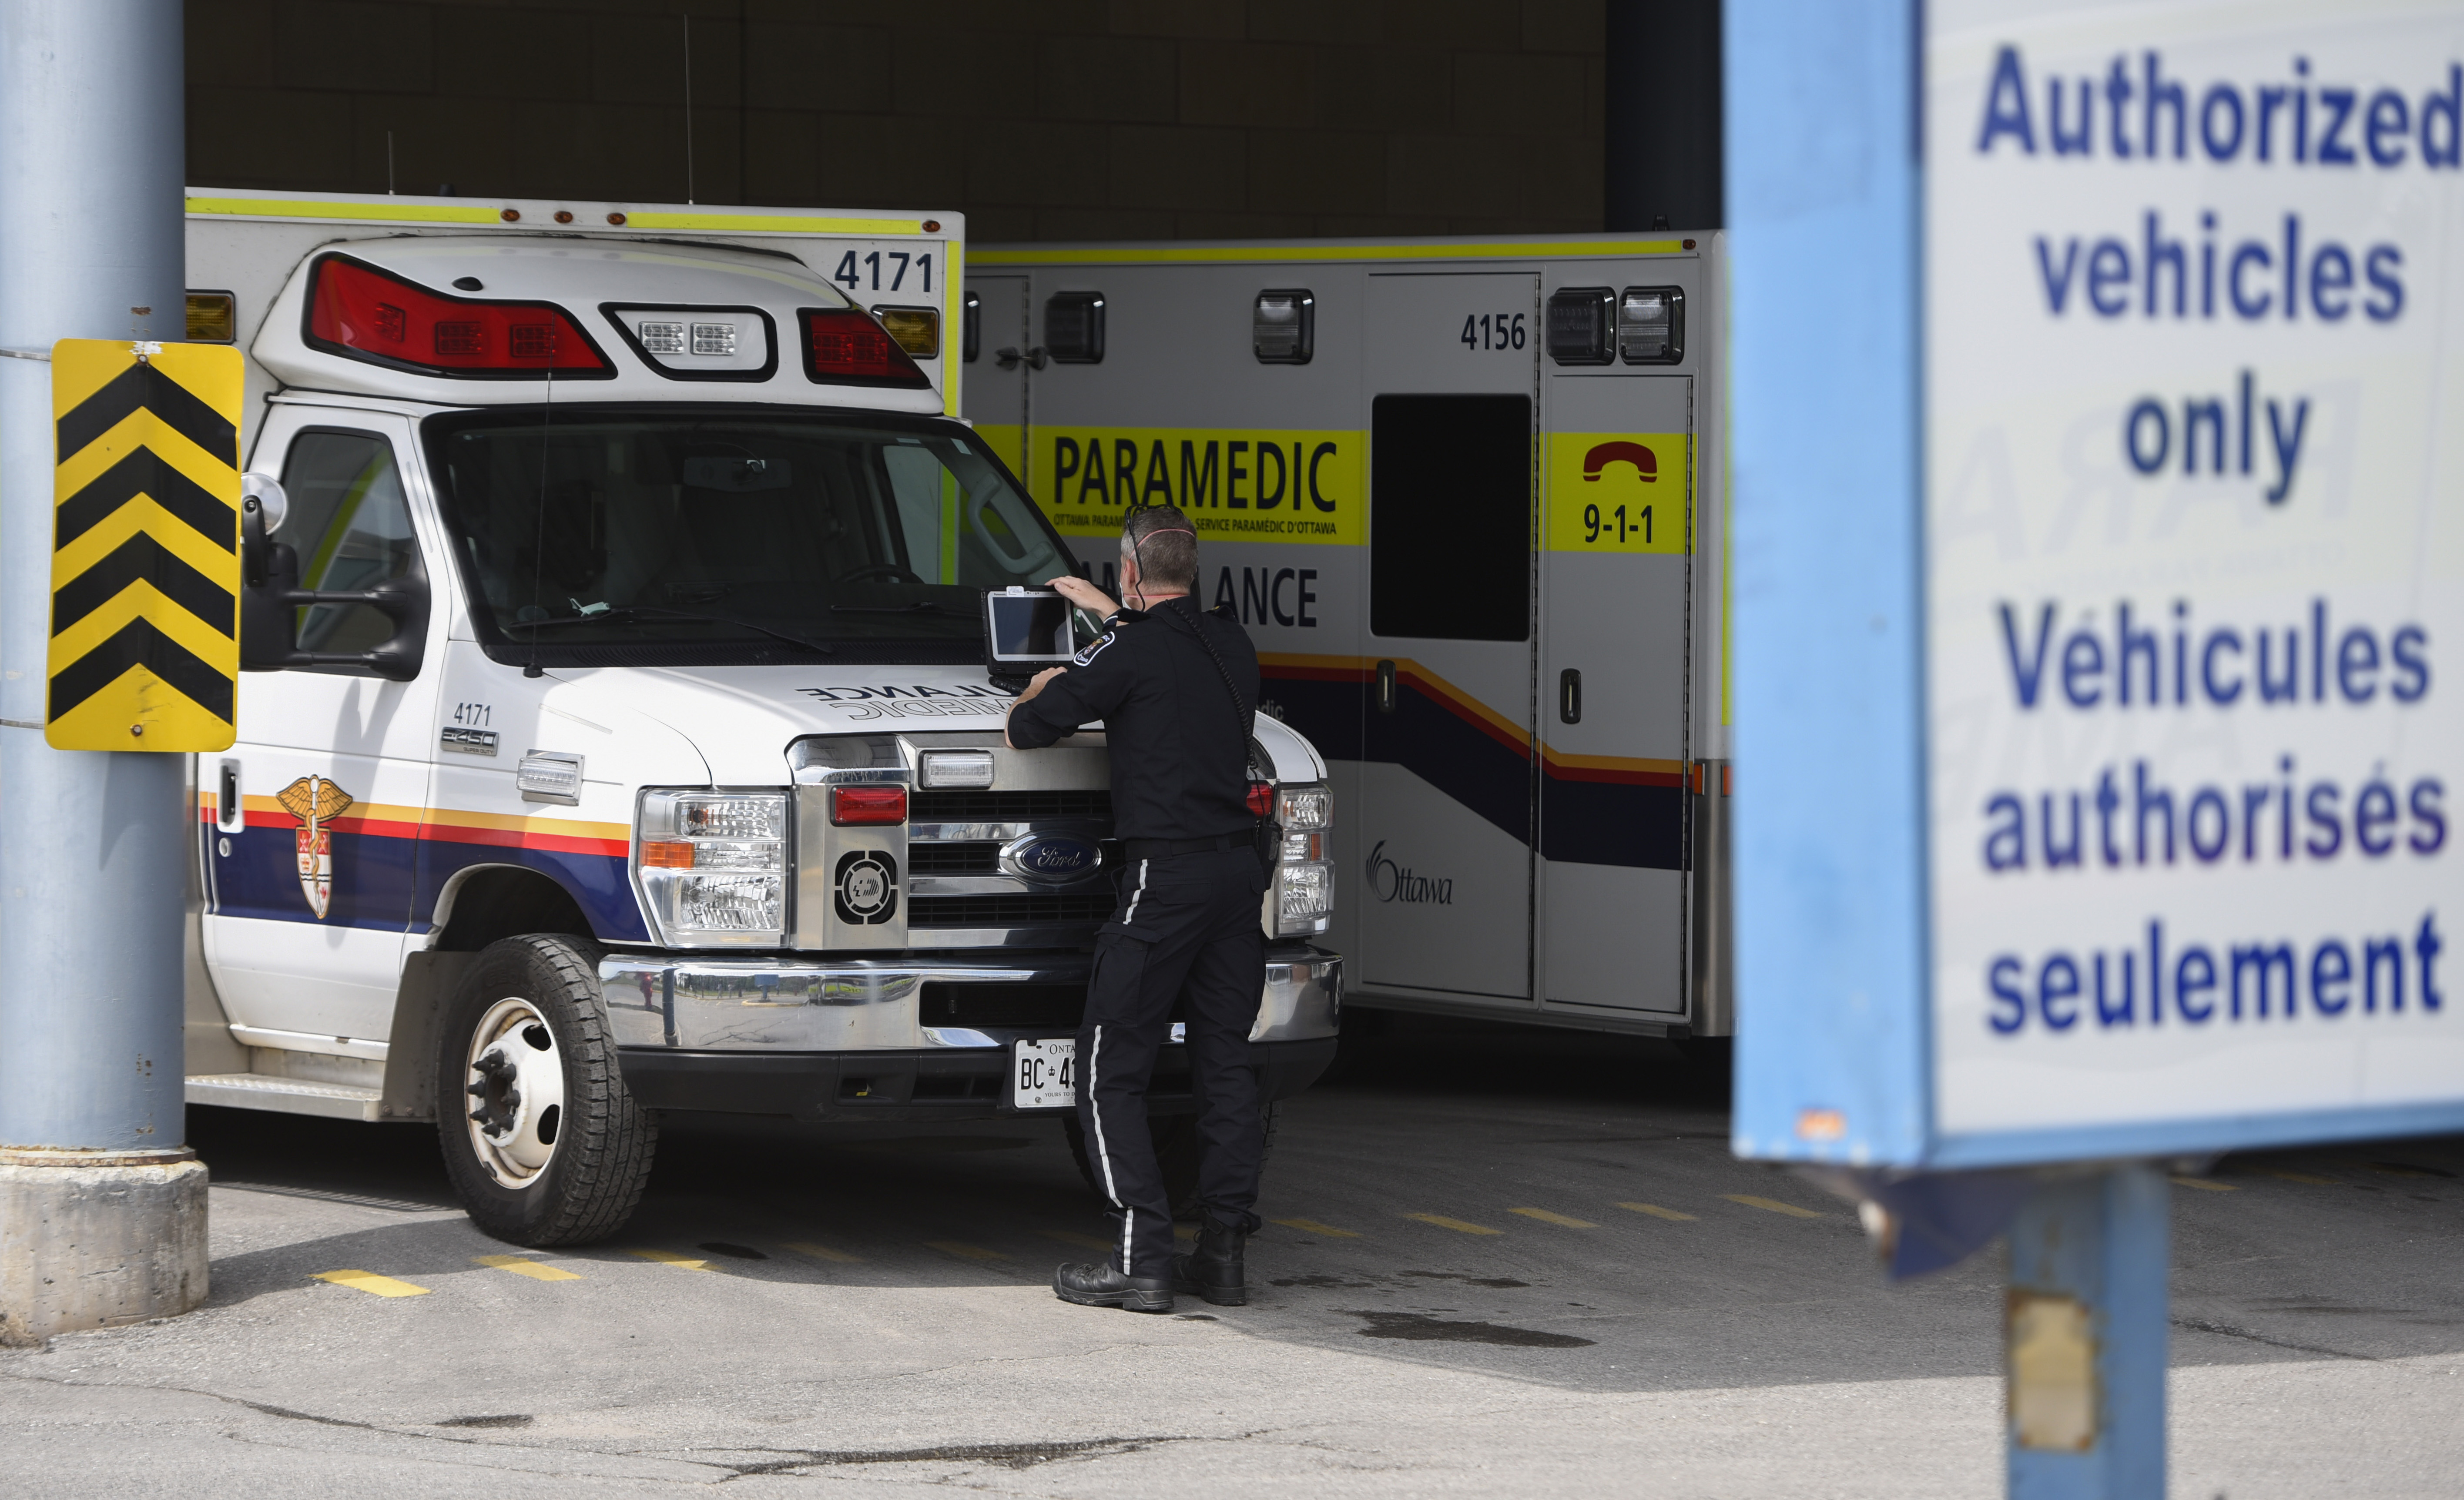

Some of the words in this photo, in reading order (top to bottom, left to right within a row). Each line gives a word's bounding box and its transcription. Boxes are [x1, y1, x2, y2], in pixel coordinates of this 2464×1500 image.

[1976, 44, 2464, 171] Authorized
[835, 250, 931, 292] 4171
[2034, 209, 2407, 325] vehicles
[1461, 313, 1525, 350] 4156
[2123, 368, 2311, 508] only
[1054, 436, 1337, 512] PARAMEDIC
[1054, 513, 1090, 526] OTTAWA
[1092, 515, 1125, 528] PARAM
[1195, 518, 1230, 531] SERVICE
[1232, 518, 1285, 533] PARAMÉDIC
[1287, 521, 1337, 535] D'OTTAWA
[1584, 504, 1652, 543] 9-1-1
[1997, 598, 2431, 711] Véhicules
[453, 702, 490, 726] 4171
[1982, 754, 2449, 874] authorisés
[1037, 847, 1080, 867] Ford
[1366, 848, 1452, 904] Ottawa
[1986, 910, 2445, 1038] seulement
[1021, 1058, 1044, 1090] BC
[1049, 1044, 1076, 1055] ONTA
